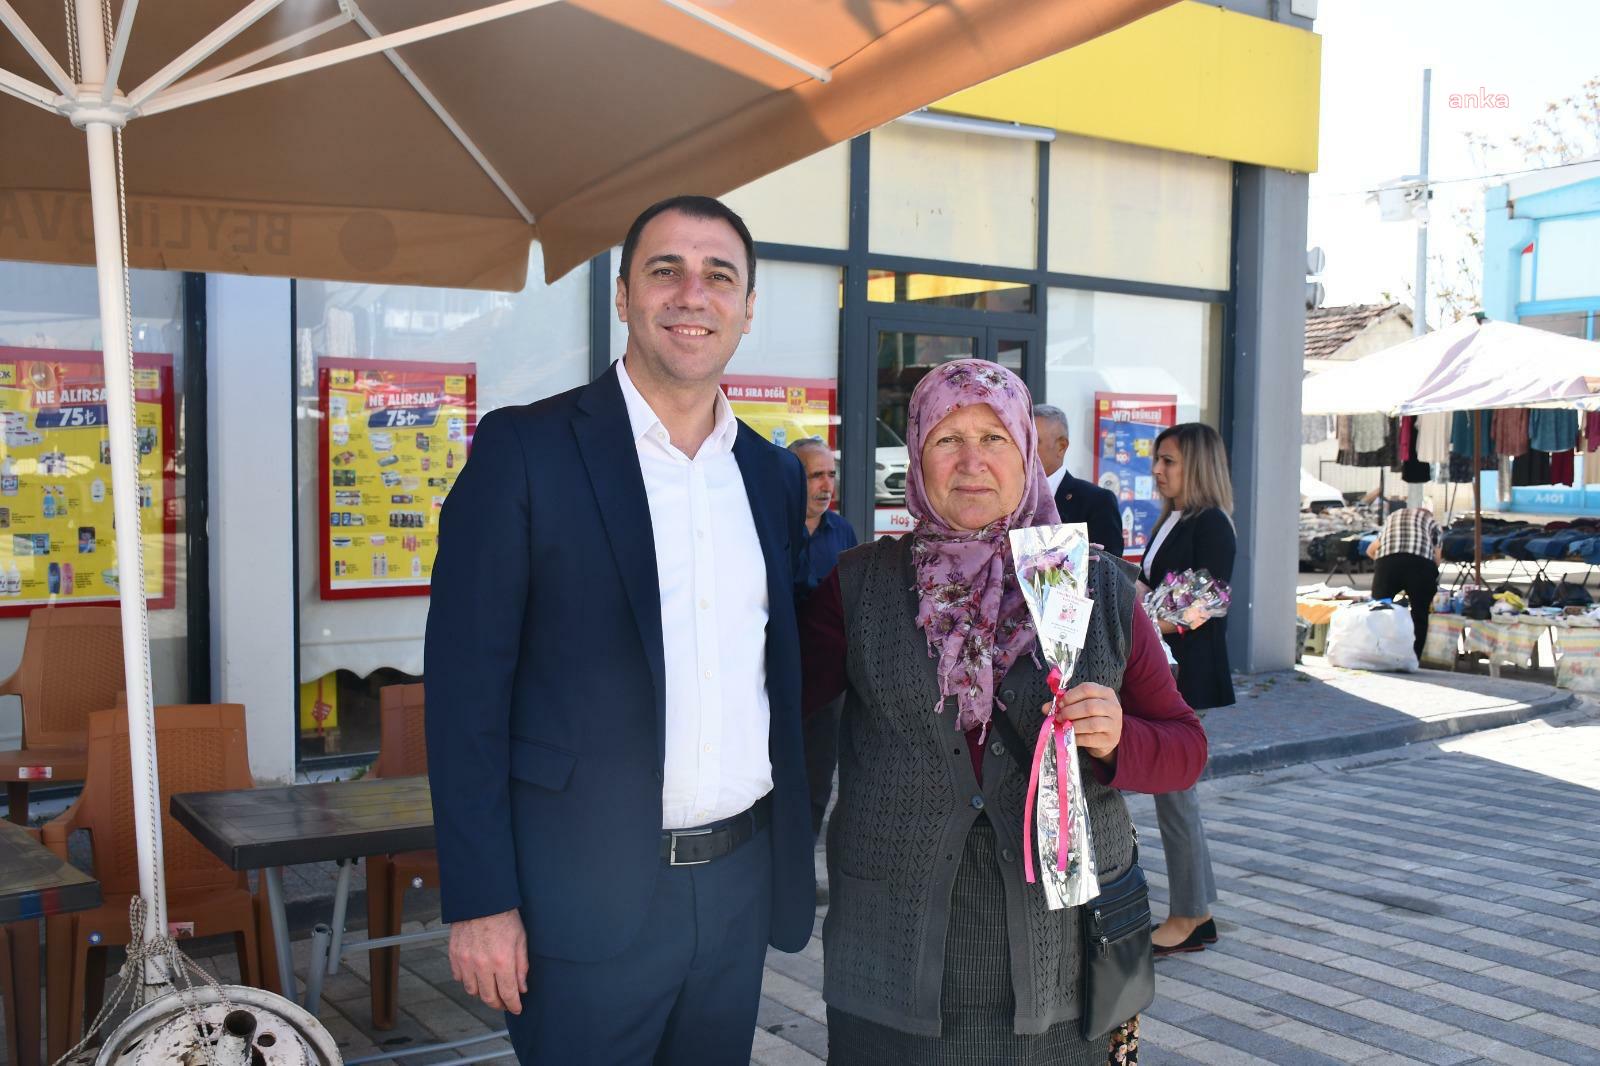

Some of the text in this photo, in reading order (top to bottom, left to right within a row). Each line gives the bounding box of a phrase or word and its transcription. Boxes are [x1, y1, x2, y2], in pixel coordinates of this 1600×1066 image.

[36, 388, 108, 404] NE ALIRSA
[727, 386, 786, 398] ARA SIRA DEĞİL
[369, 392, 435, 407] NE ALIRSAN
[890, 514, 910, 527] Hoş
